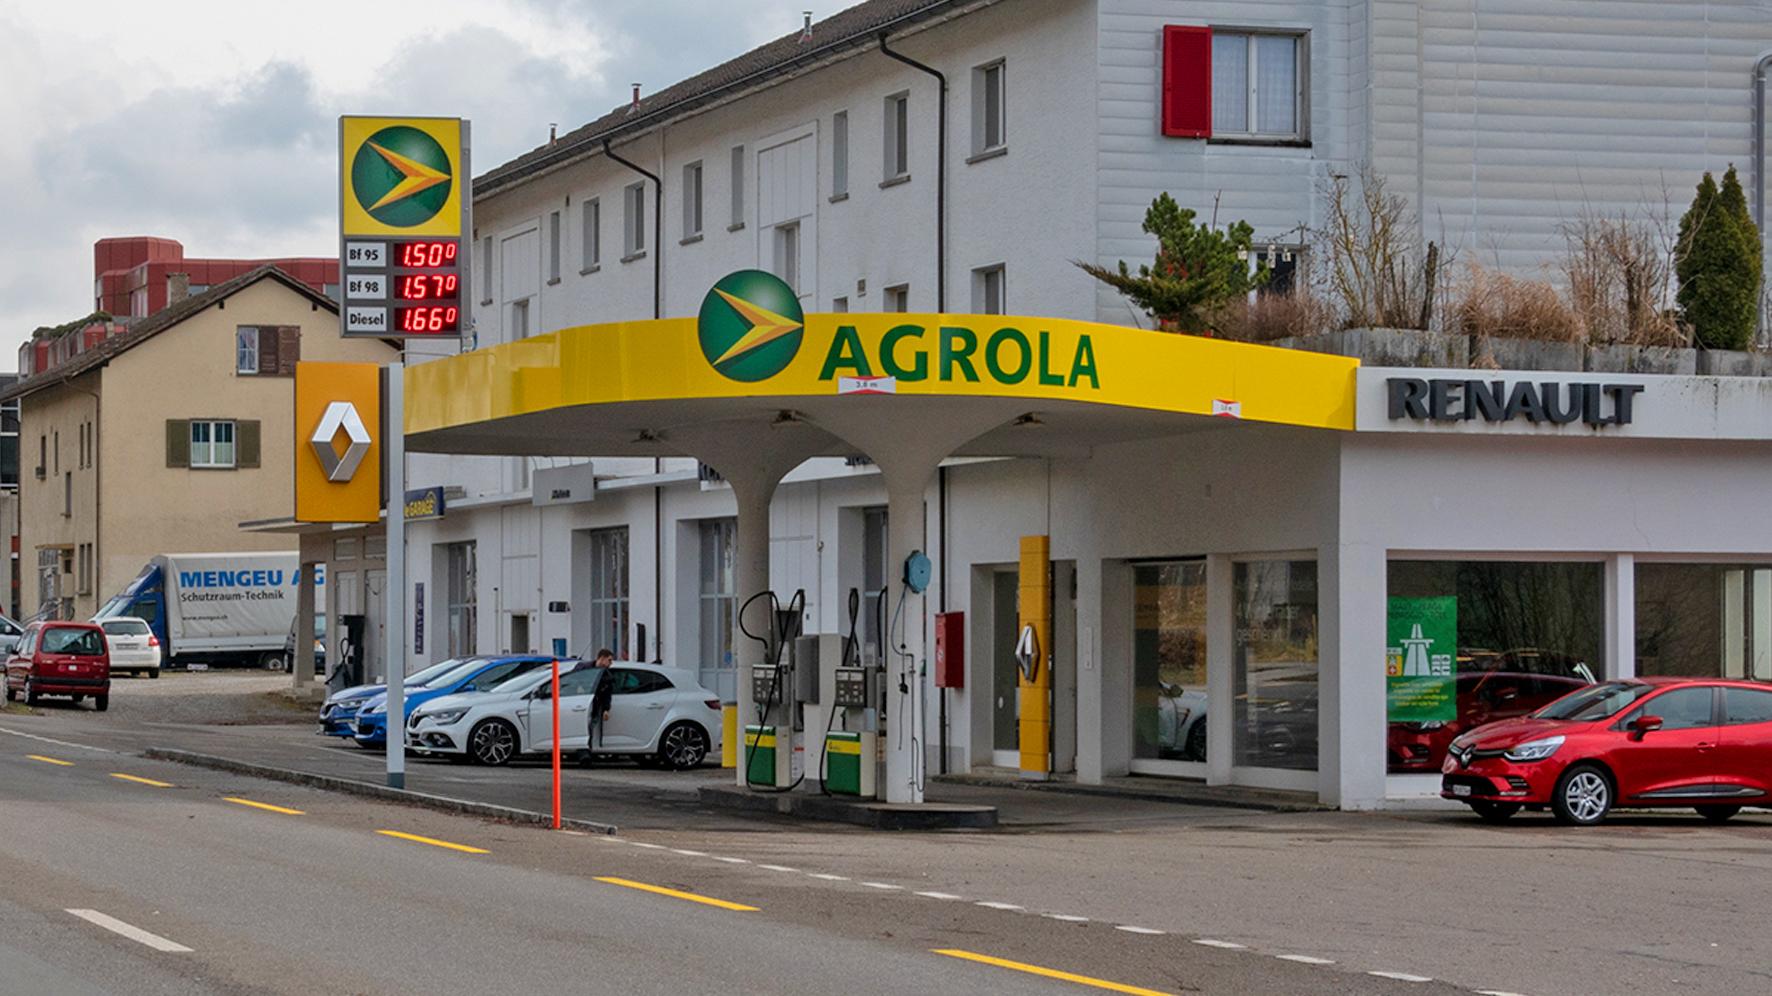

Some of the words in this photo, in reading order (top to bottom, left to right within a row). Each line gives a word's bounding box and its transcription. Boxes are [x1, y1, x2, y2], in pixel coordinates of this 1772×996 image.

[349, 248, 362, 261] Bf
[364, 249, 379, 261] 95
[349, 281, 362, 293] Bf
[364, 281, 379, 293] 98
[349, 312, 384, 325] Diesel
[818, 324, 1100, 389] AGROLA
[1386, 377, 1645, 424] RENAULT
[180, 569, 283, 588] MENGEU
[180, 590, 285, 602] Schutzraum-Technik
